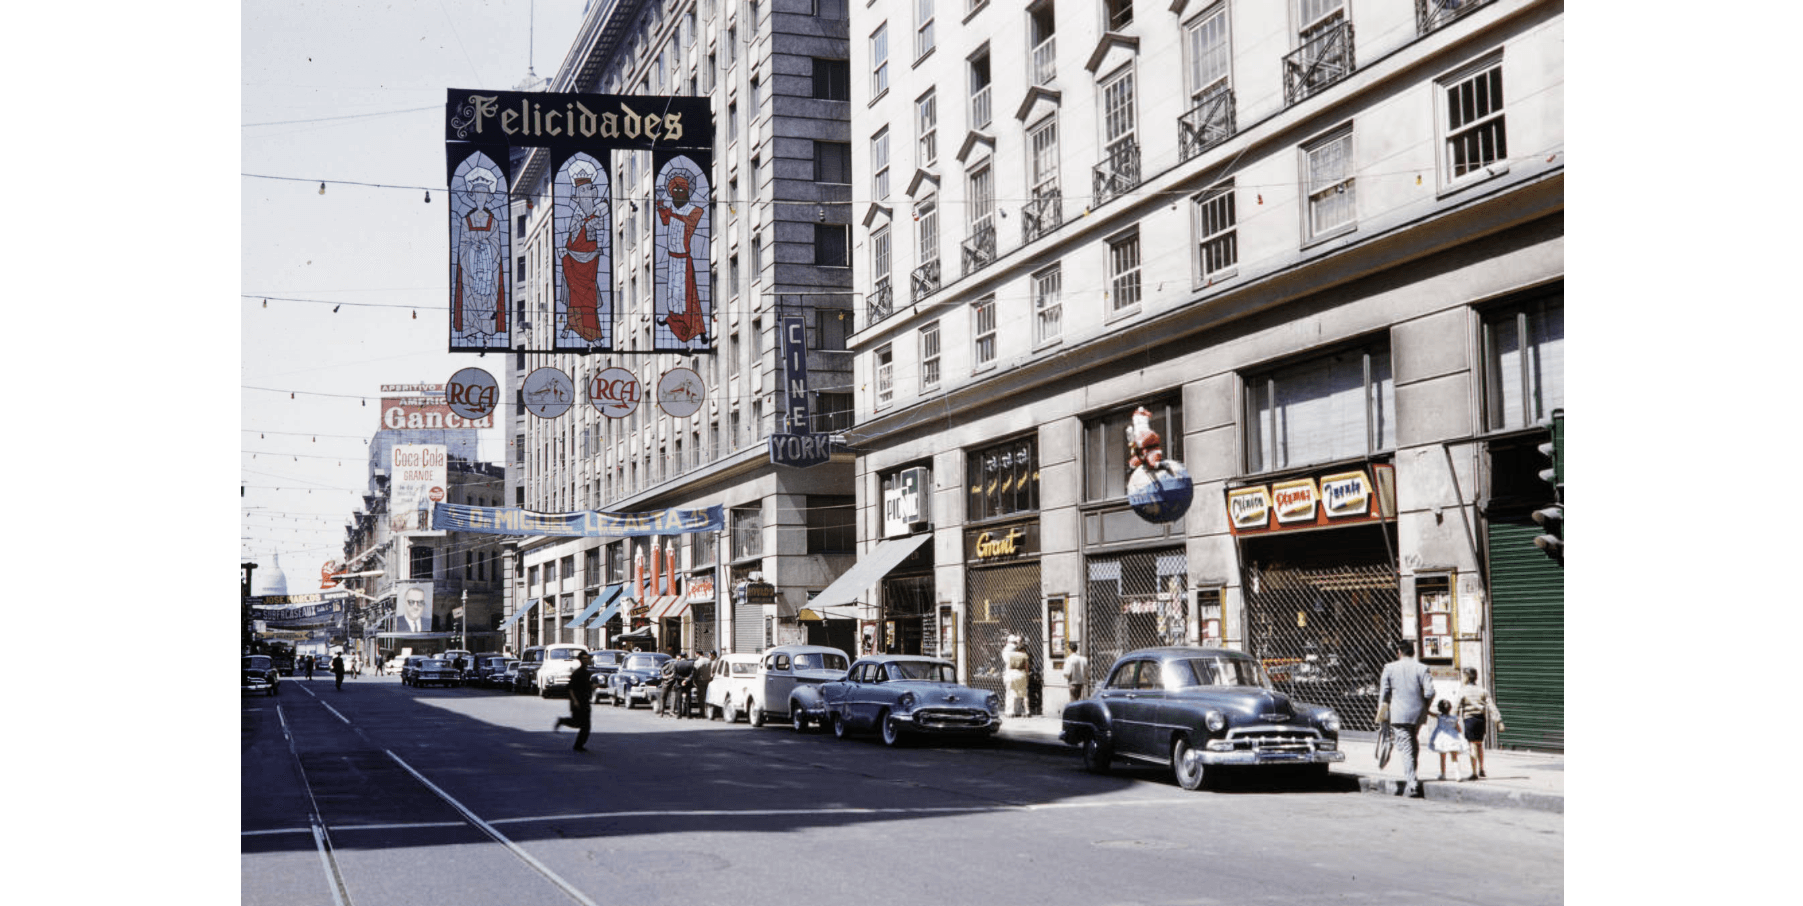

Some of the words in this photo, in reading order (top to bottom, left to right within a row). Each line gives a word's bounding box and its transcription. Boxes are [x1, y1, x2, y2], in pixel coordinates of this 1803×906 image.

[451, 95, 683, 141] Felicidades
[382, 384, 437, 392] APERITIVO
[789, 324, 806, 427] CINE
[399, 398, 447, 406] AMERIC
[448, 382, 496, 413] RCA
[590, 378, 640, 409] RCA
[773, 435, 829, 461] YORK
[404, 470, 434, 481] GRANDE
[494, 509, 573, 531] MIGUEL
[585, 508, 682, 532] LEZAETA
[976, 528, 1022, 558] Grant
[263, 595, 285, 605] JOSE
[287, 593, 321, 604] MARCOS
